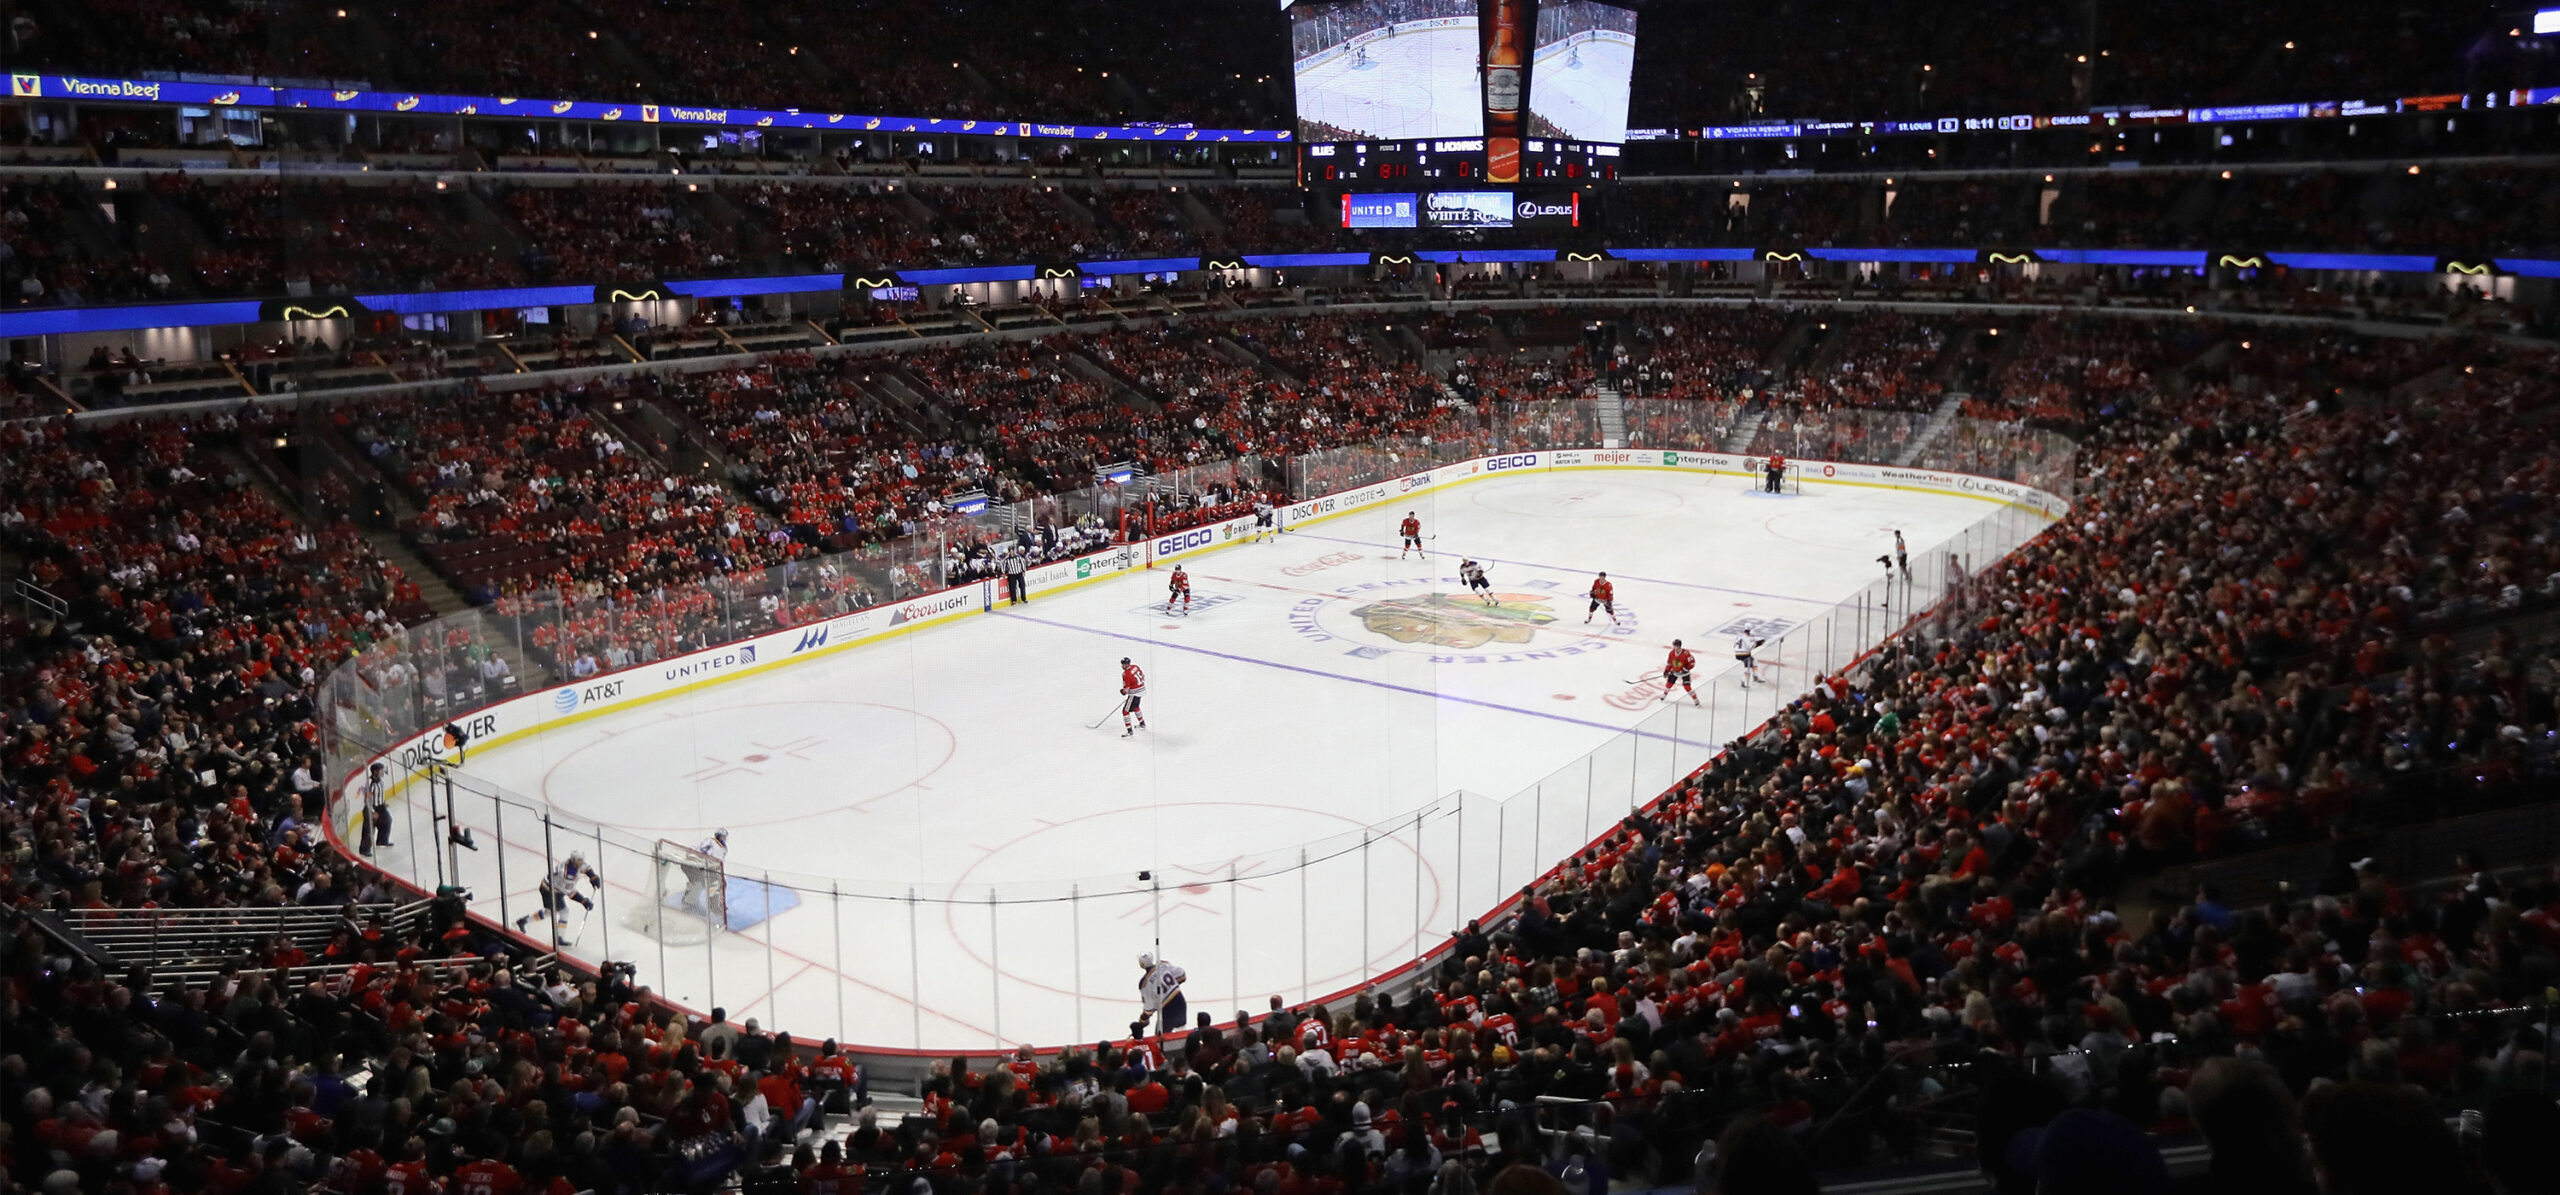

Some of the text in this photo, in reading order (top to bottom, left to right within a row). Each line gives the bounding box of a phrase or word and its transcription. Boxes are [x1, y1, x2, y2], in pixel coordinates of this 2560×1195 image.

[62, 78, 121, 96] Vienna
[122, 81, 160, 101] Beef
[671, 107, 704, 121] Vienna
[705, 110, 728, 124] Beef
[2051, 115, 2090, 125] CHICAGO
[1038, 125, 1060, 136] Vienna
[1060, 127, 1075, 138] Beef
[1909, 121, 1933, 131] LOUIS
[1964, 118, 1994, 130] 18:11
[1311, 145, 1335, 156] BLUES
[1435, 141, 1483, 152] BLACKHAWKS
[1359, 157, 1366, 166] 2
[1326, 165, 1335, 180] 0
[1460, 161, 1469, 177] 0
[1427, 193, 1463, 210] Captain
[1351, 205, 1393, 216] UNITED
[1427, 211, 1503, 223] WHITE RUM
[1537, 206, 1573, 215] LEXUS
[1486, 454, 1537, 471] GEICO
[1593, 450, 1631, 465] meijer
[1666, 454, 1729, 467] enterprise
[1411, 473, 1431, 488] bank
[1881, 470, 1953, 483] WeatherTech
[1976, 482, 2020, 497] LEXUS
[1343, 491, 1376, 507] COYOTE
[1292, 498, 1336, 521] DISCOVER
[1158, 528, 1213, 556] GEICO
[1050, 566, 1069, 581] bank
[903, 595, 969, 622] Coors LIGHT
[666, 654, 735, 681] UNITED
[583, 680, 625, 704] AT&T
